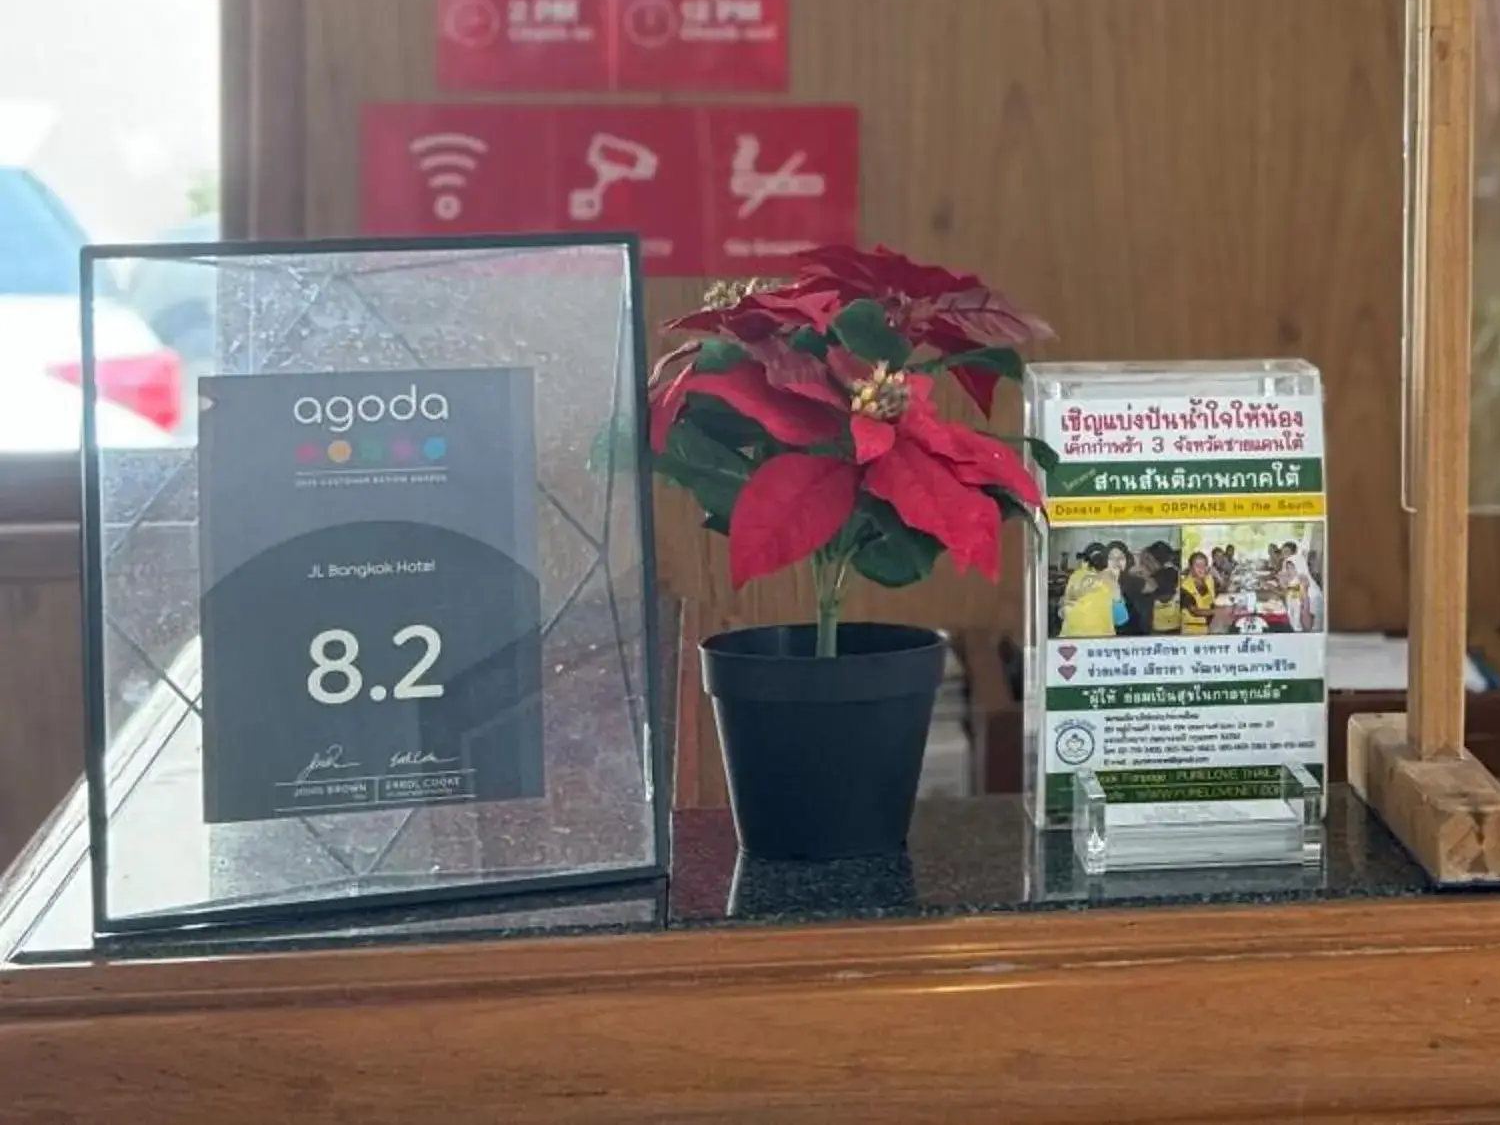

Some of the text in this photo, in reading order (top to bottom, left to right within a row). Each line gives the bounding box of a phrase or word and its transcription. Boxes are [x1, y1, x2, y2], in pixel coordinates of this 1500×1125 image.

[293, 383, 449, 432] agoda
[1151, 436, 1165, 454] 3
[1161, 499, 1227, 514] ORPHANS
[328, 561, 394, 579] Bangkok
[396, 558, 437, 574] Hotel
[307, 623, 445, 705] 8.2
